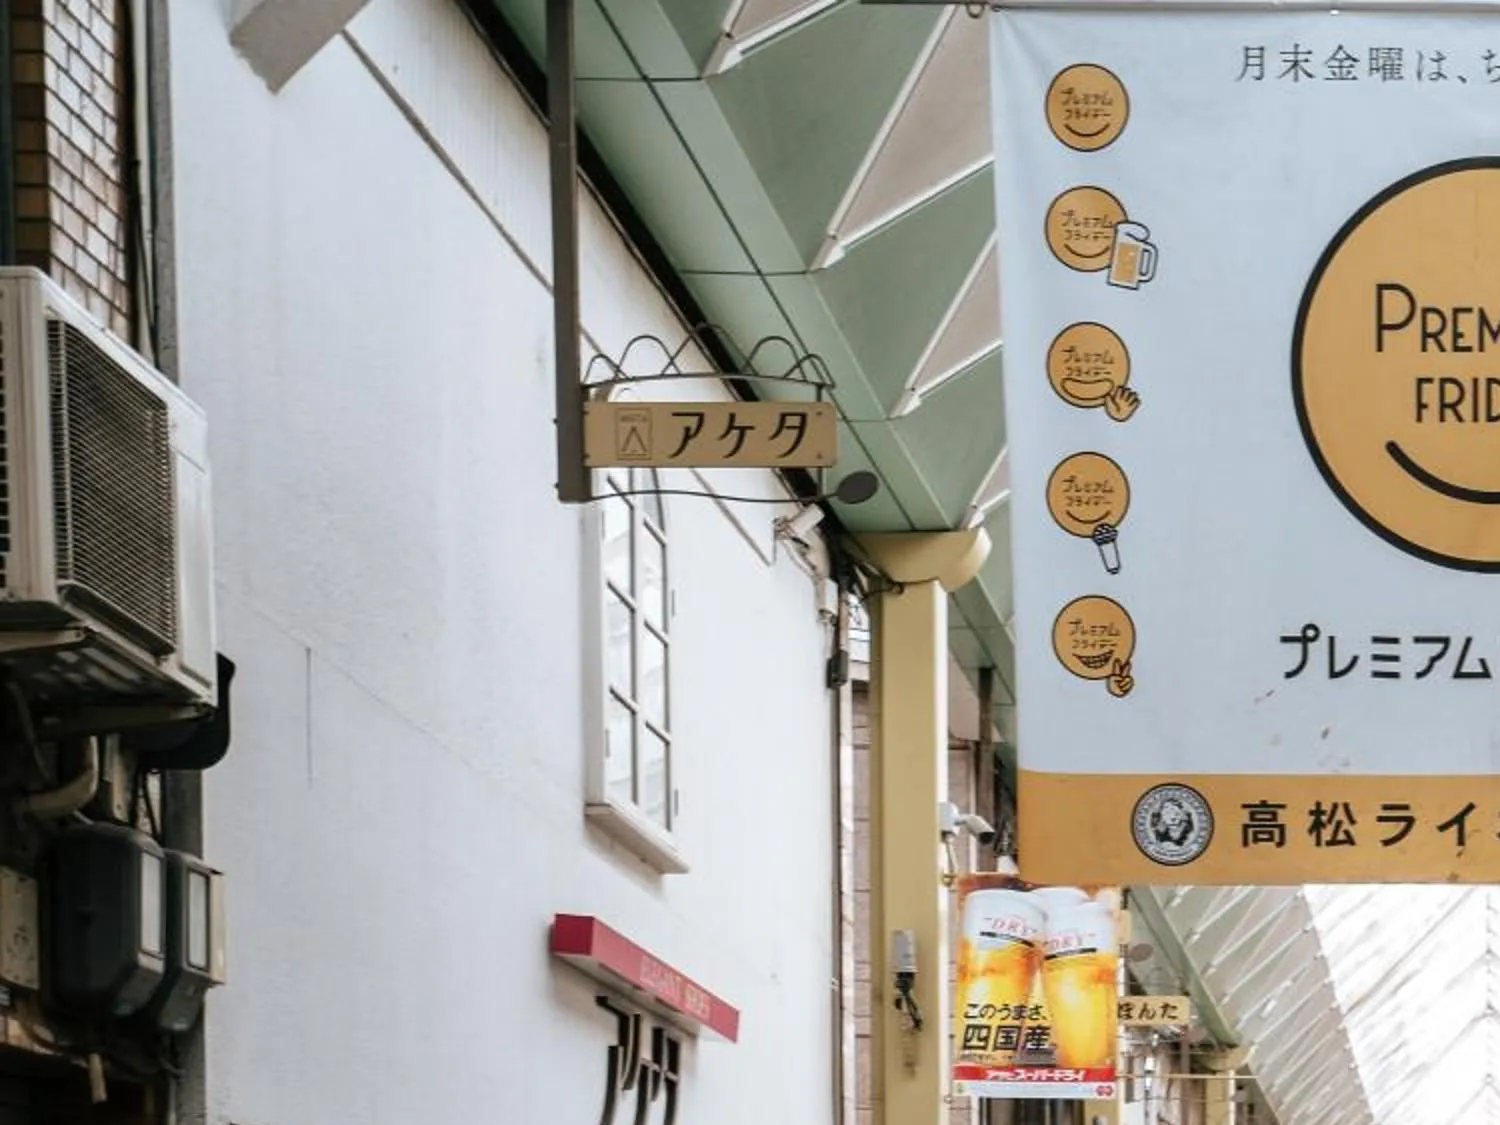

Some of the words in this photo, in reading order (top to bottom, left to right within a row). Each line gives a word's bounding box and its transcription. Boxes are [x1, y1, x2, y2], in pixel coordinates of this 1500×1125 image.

[667, 411, 808, 459] アケタ
[963, 1003, 1047, 1021] このうまさ、
